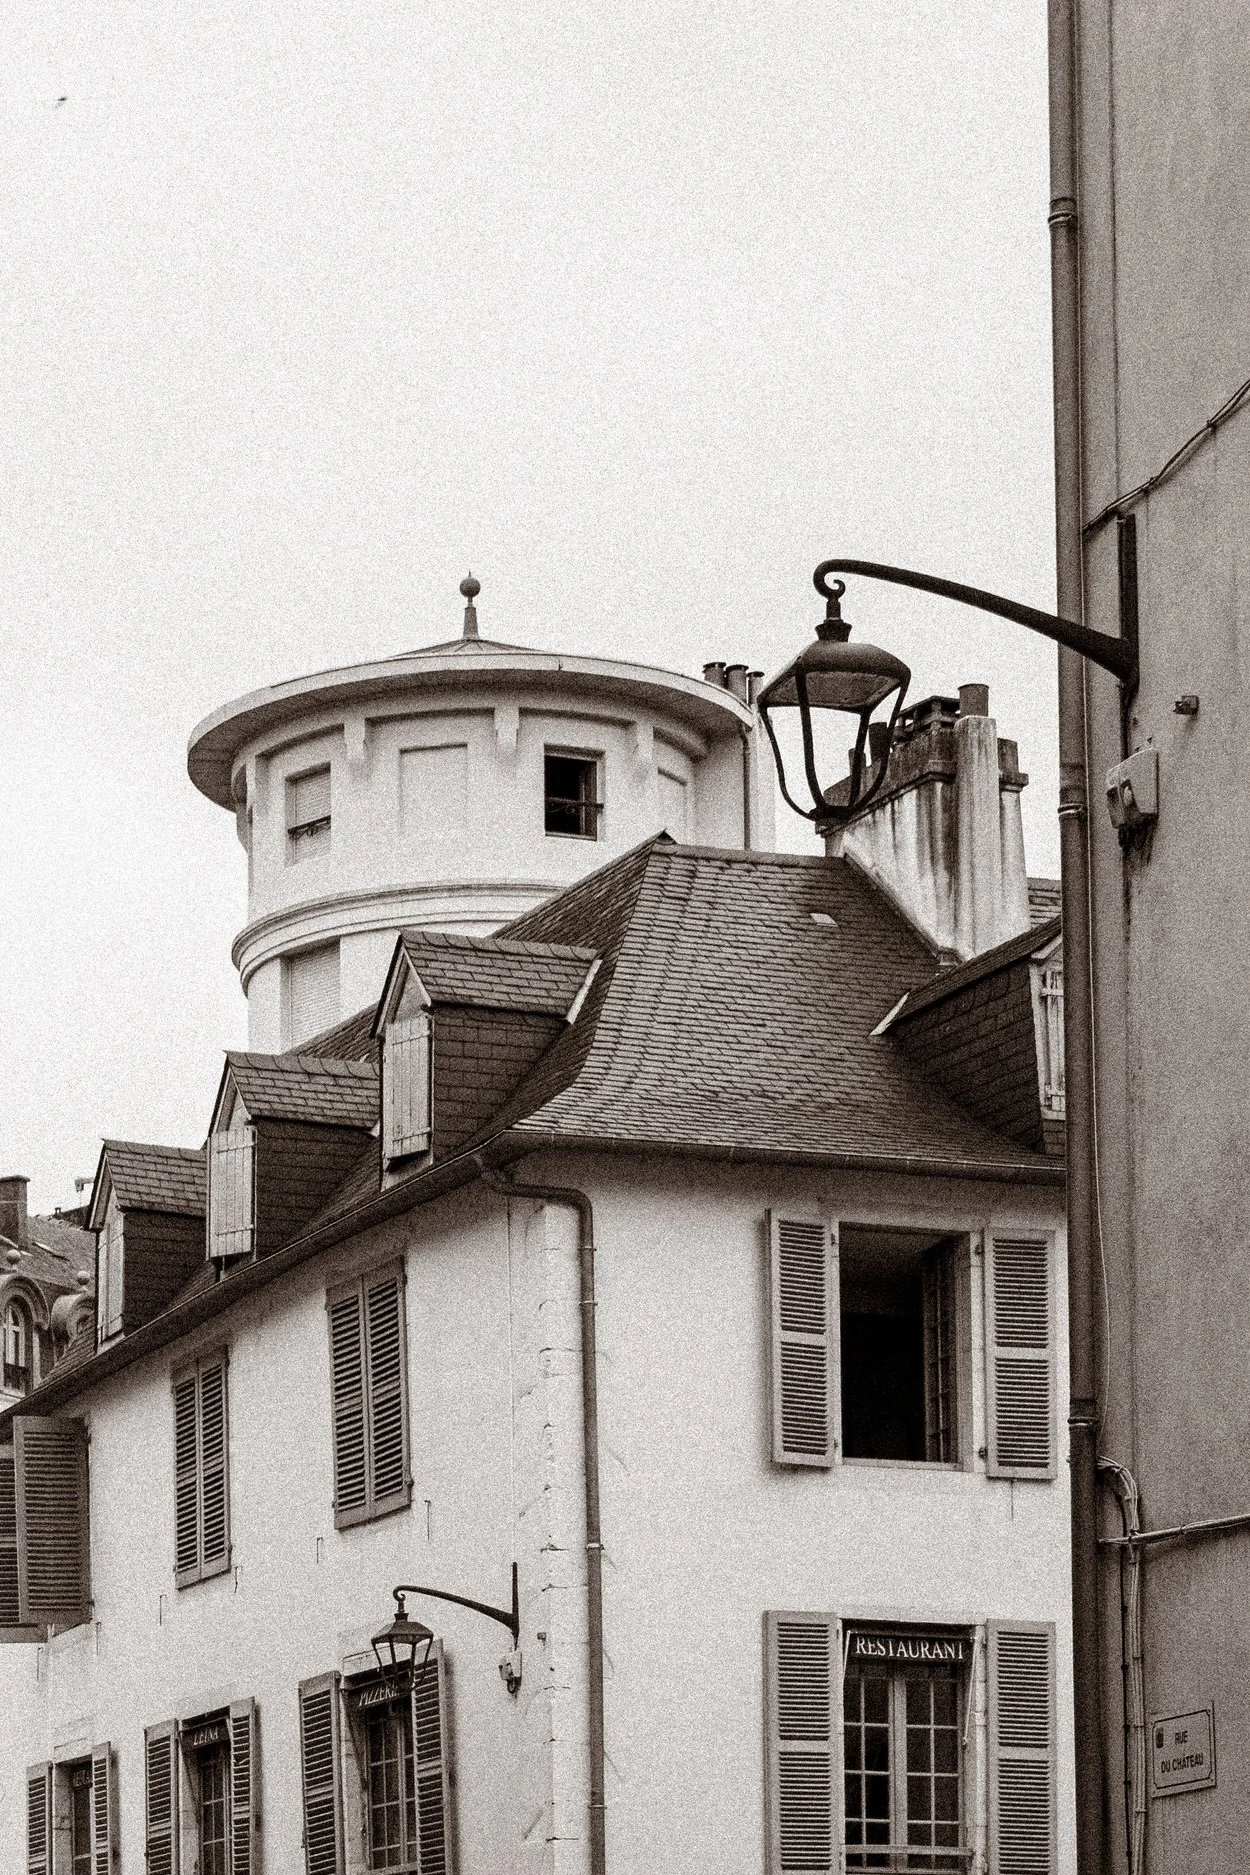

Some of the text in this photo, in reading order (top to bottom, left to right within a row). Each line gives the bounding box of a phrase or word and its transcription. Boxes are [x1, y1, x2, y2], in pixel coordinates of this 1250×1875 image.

[855, 1636, 964, 1659] RESTAURANT
[1174, 1730, 1188, 1745] RUE
[1160, 1761, 1171, 1773] DU
